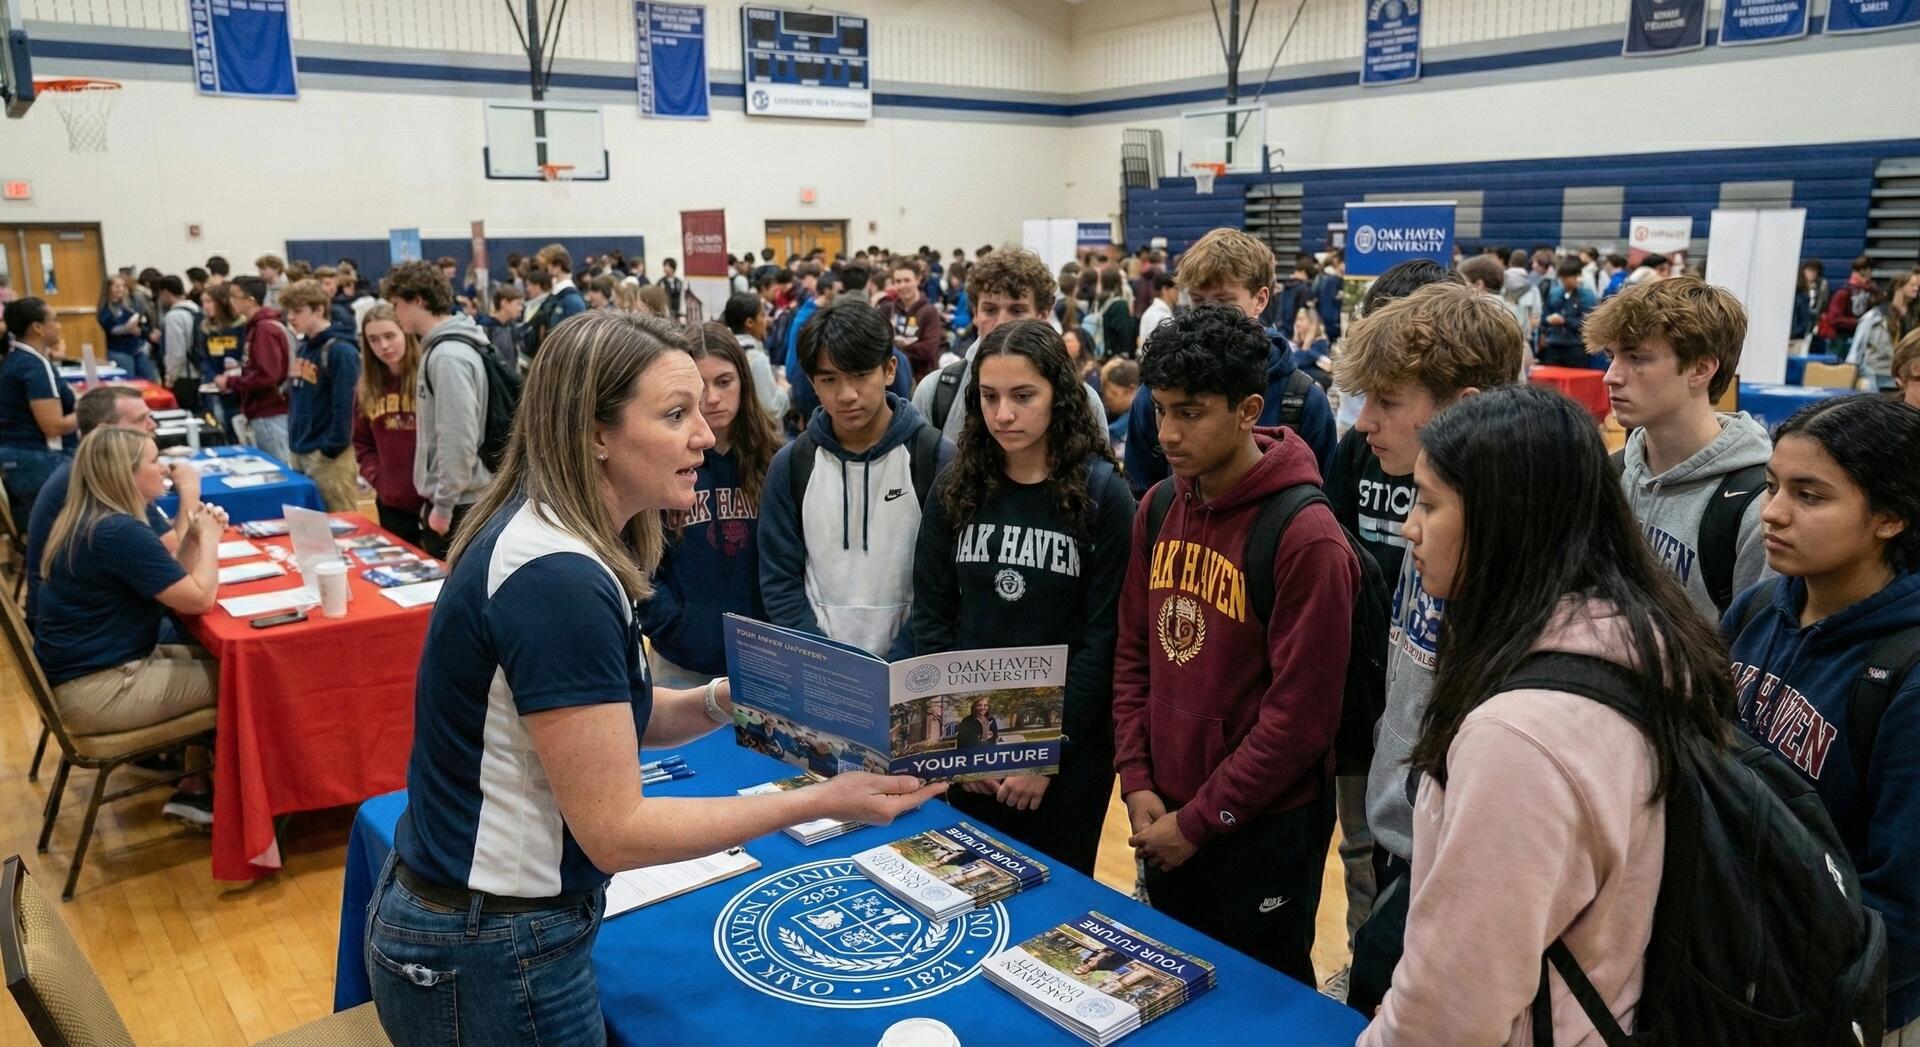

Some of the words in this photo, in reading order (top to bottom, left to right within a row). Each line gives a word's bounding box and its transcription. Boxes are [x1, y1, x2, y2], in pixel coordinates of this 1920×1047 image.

[1377, 240, 1444, 252] UNIVERSITY
[1378, 228, 1403, 240] OAK
[1405, 228, 1446, 240] HAVEN
[955, 524, 996, 563] AK
[997, 524, 1080, 577] HAVEN
[1149, 540, 1181, 590] AK
[1180, 542, 1246, 623] HAVEN
[948, 659, 990, 675] OAK
[990, 656, 1053, 672] HAVEN
[948, 668, 1053, 686] UNIVERSITY
[913, 756, 967, 773] YOUR
[973, 748, 1049, 766] FUTURE
[990, 852, 1027, 874] YOUR
[731, 900, 768, 965] HAVEN
[1079, 919, 1141, 952] FUTURE
[1140, 949, 1186, 974] YOUR
[904, 960, 965, 991] 1821
